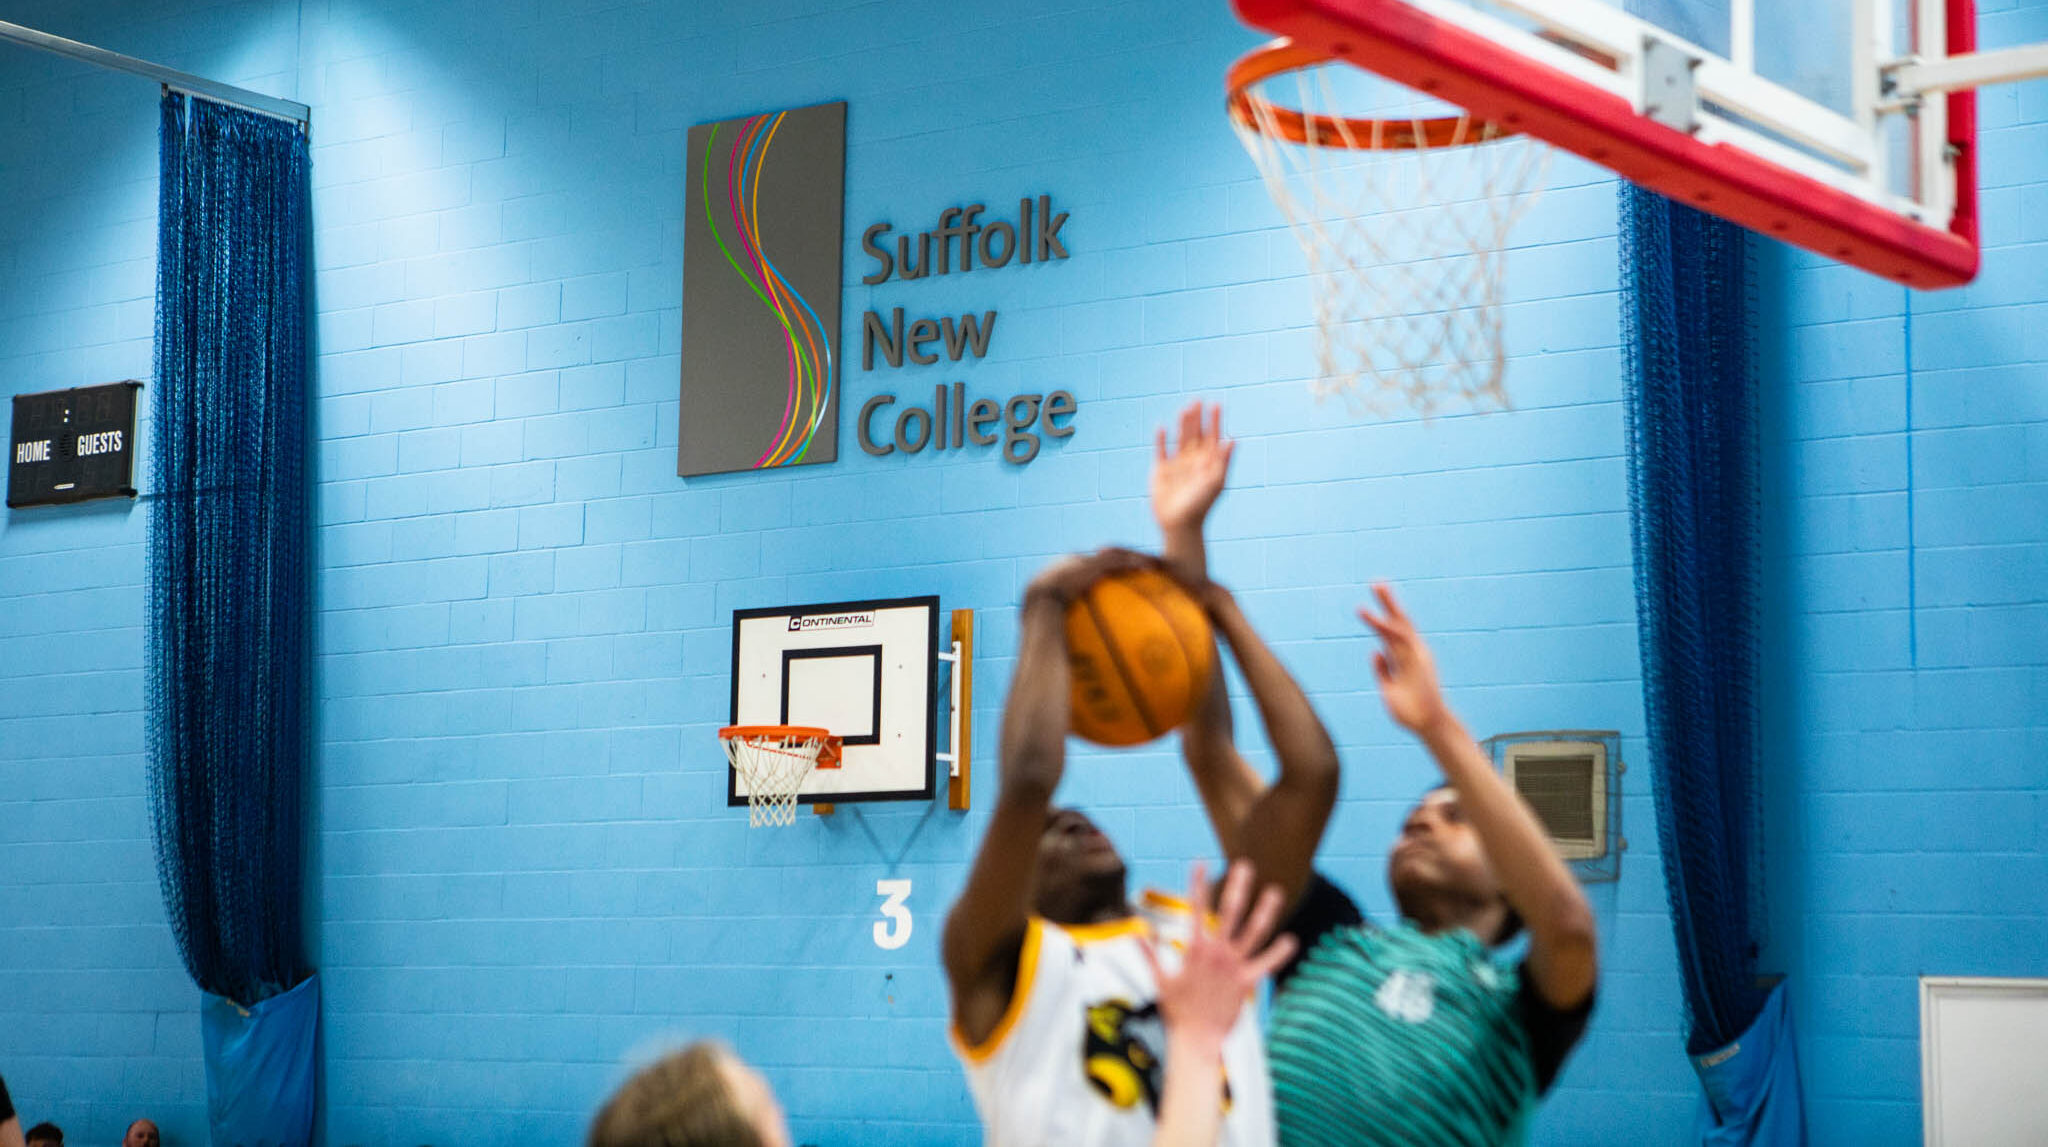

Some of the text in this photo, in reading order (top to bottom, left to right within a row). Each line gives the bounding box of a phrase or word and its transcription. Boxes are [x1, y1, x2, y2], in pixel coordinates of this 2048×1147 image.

[862, 195, 1070, 284] Suffolk
[863, 307, 996, 371] New
[17, 430, 122, 463] HOME GUESTS
[858, 382, 1077, 464] College
[789, 615, 872, 631] CONTINENTAL
[873, 879, 912, 950] 3
